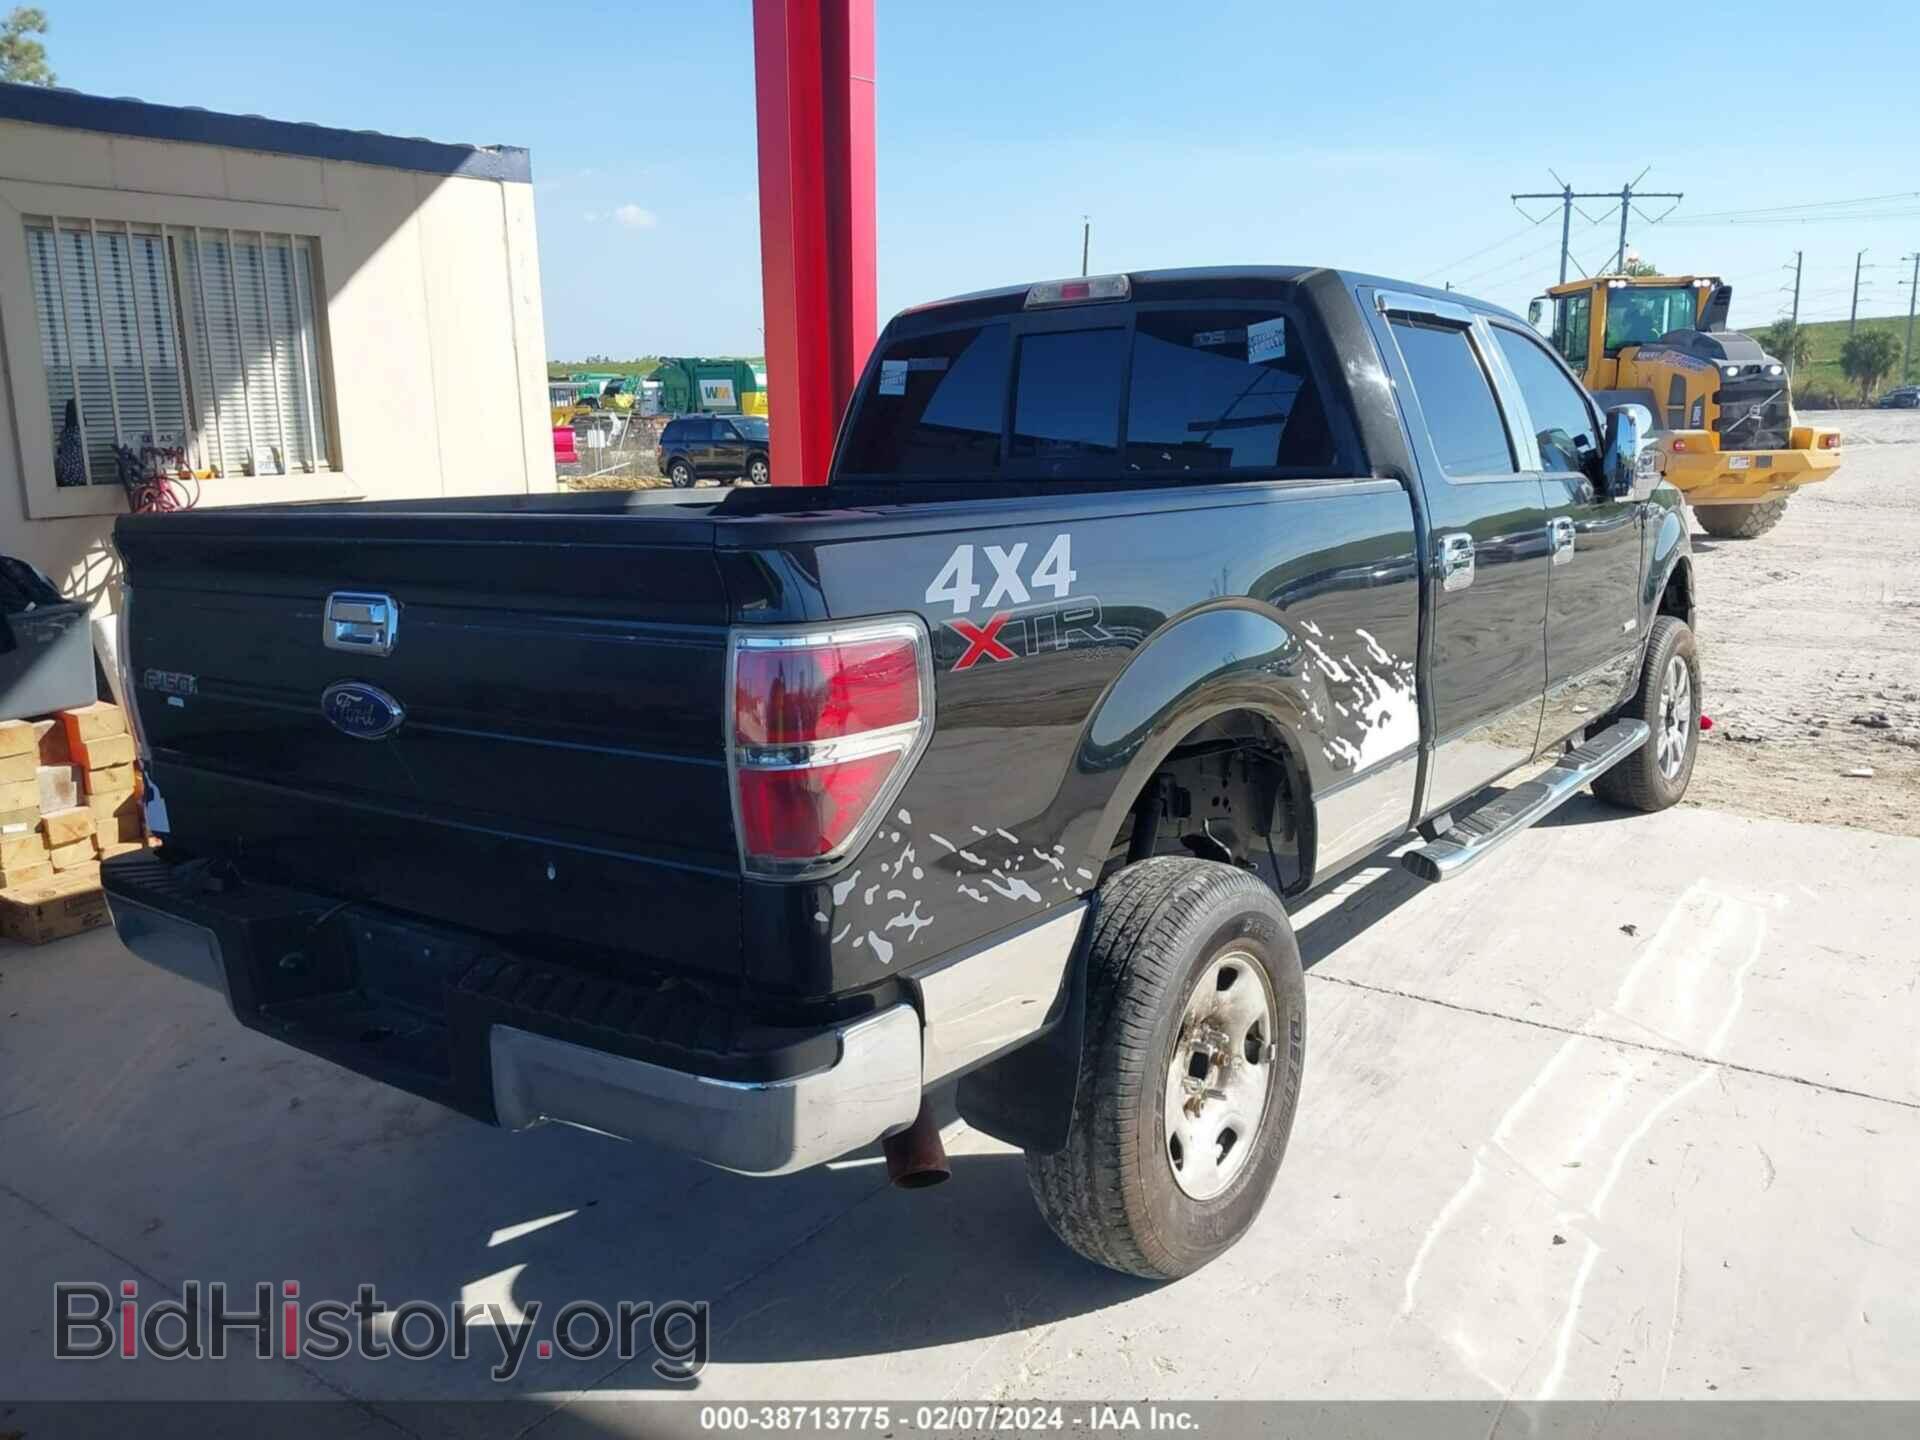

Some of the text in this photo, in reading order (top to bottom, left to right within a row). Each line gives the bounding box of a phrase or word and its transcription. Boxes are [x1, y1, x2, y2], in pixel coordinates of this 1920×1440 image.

[925, 533, 1077, 614] 4X4
[942, 595, 1114, 672] XTR
[335, 692, 376, 727] Ford
